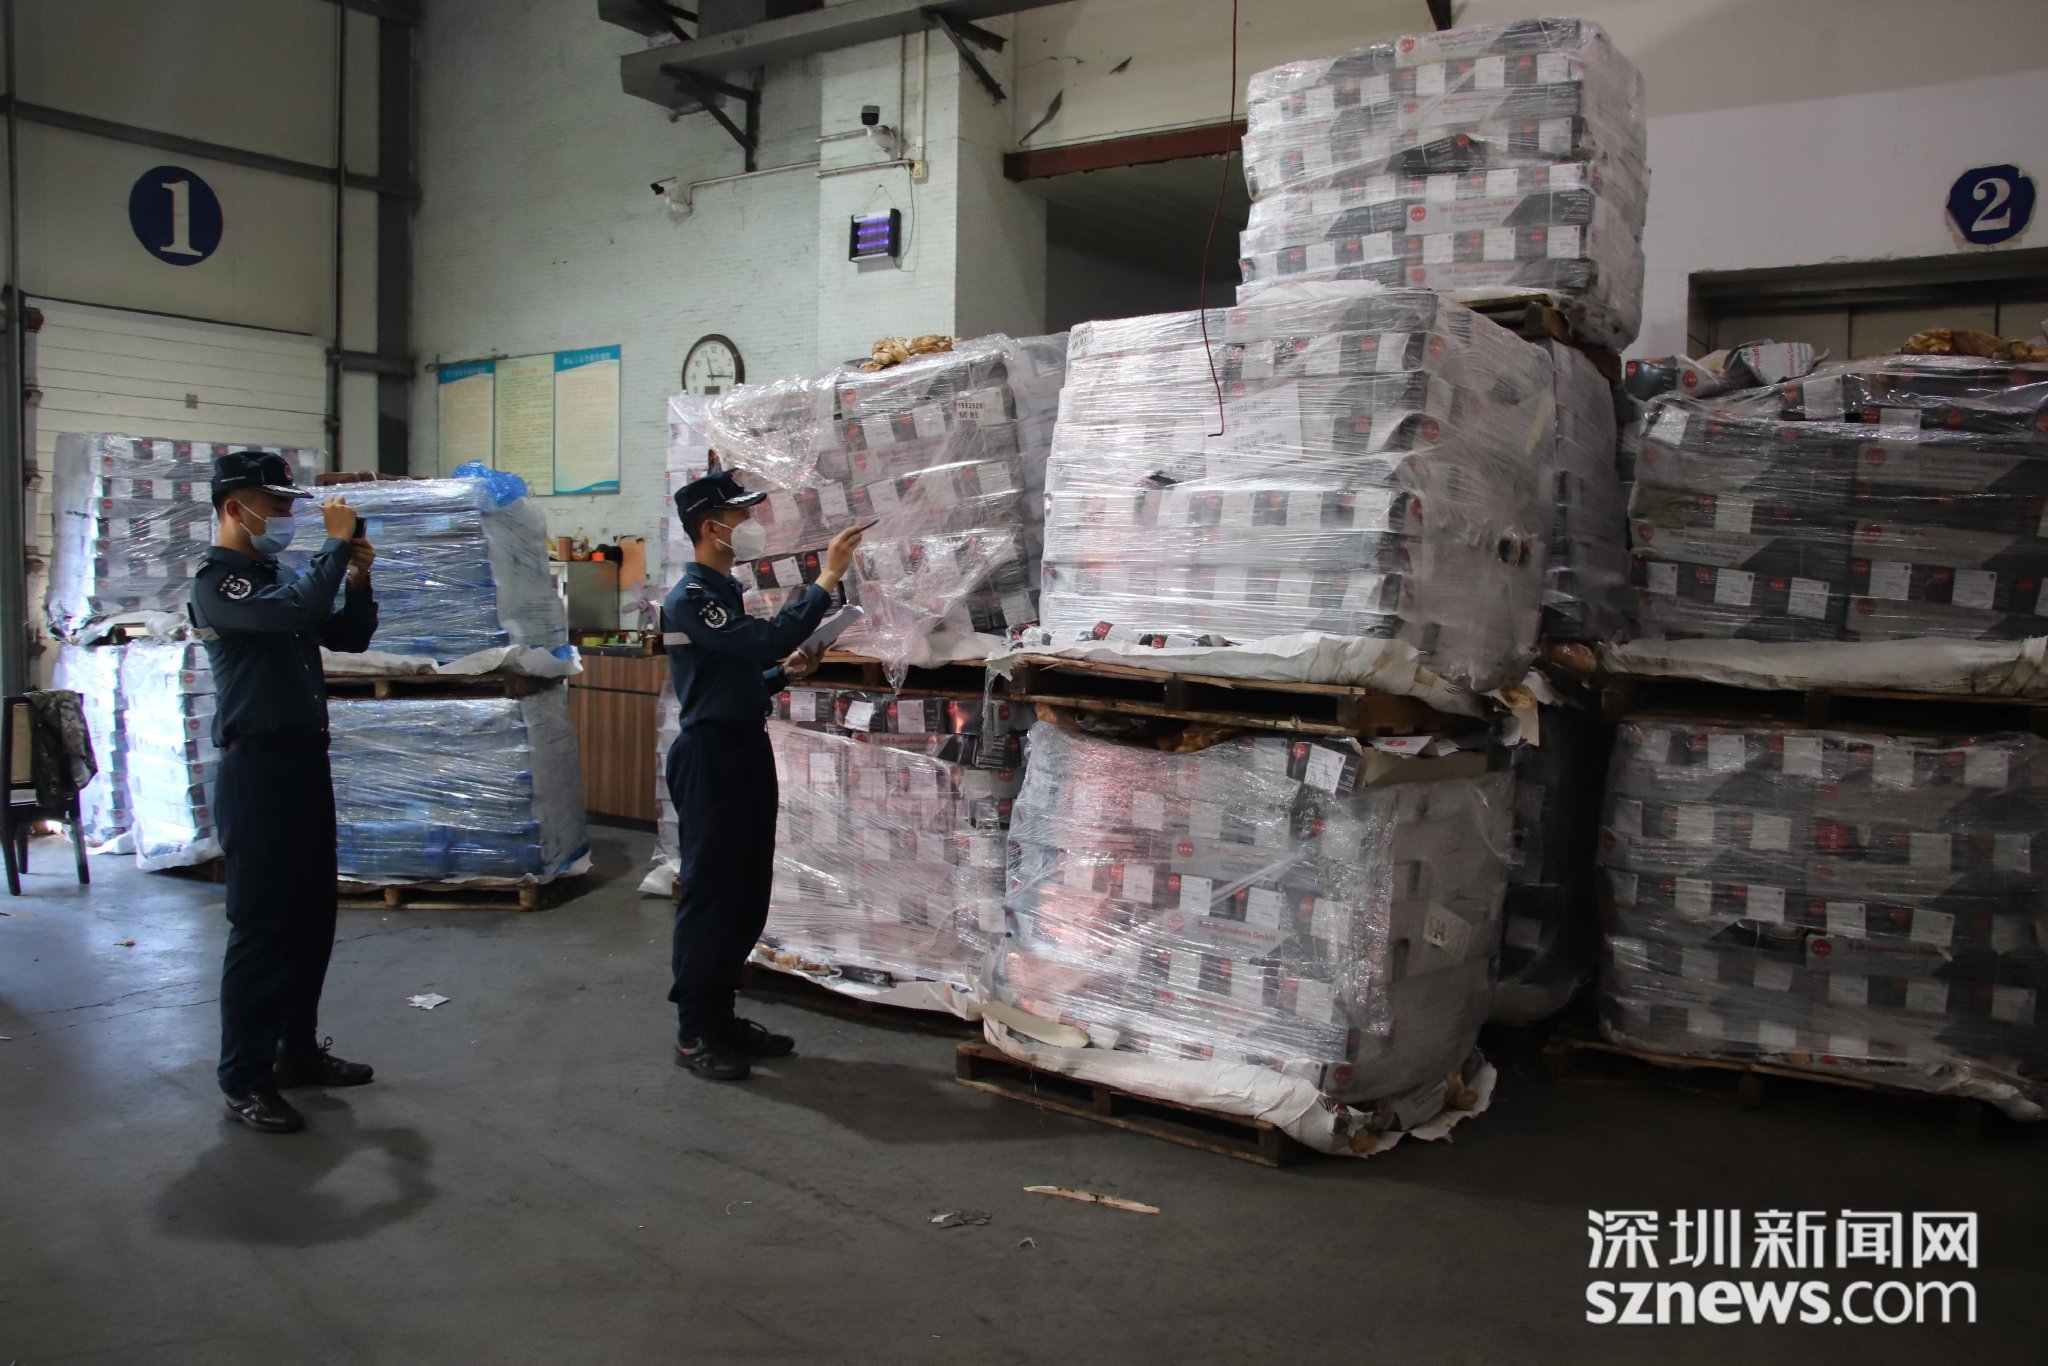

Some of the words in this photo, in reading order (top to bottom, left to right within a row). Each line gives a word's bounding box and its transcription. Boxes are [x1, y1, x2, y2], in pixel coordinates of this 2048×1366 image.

[160, 180, 203, 257] 1
[1971, 178, 2012, 232] 2
[1253, 931, 1276, 943] GmbH
